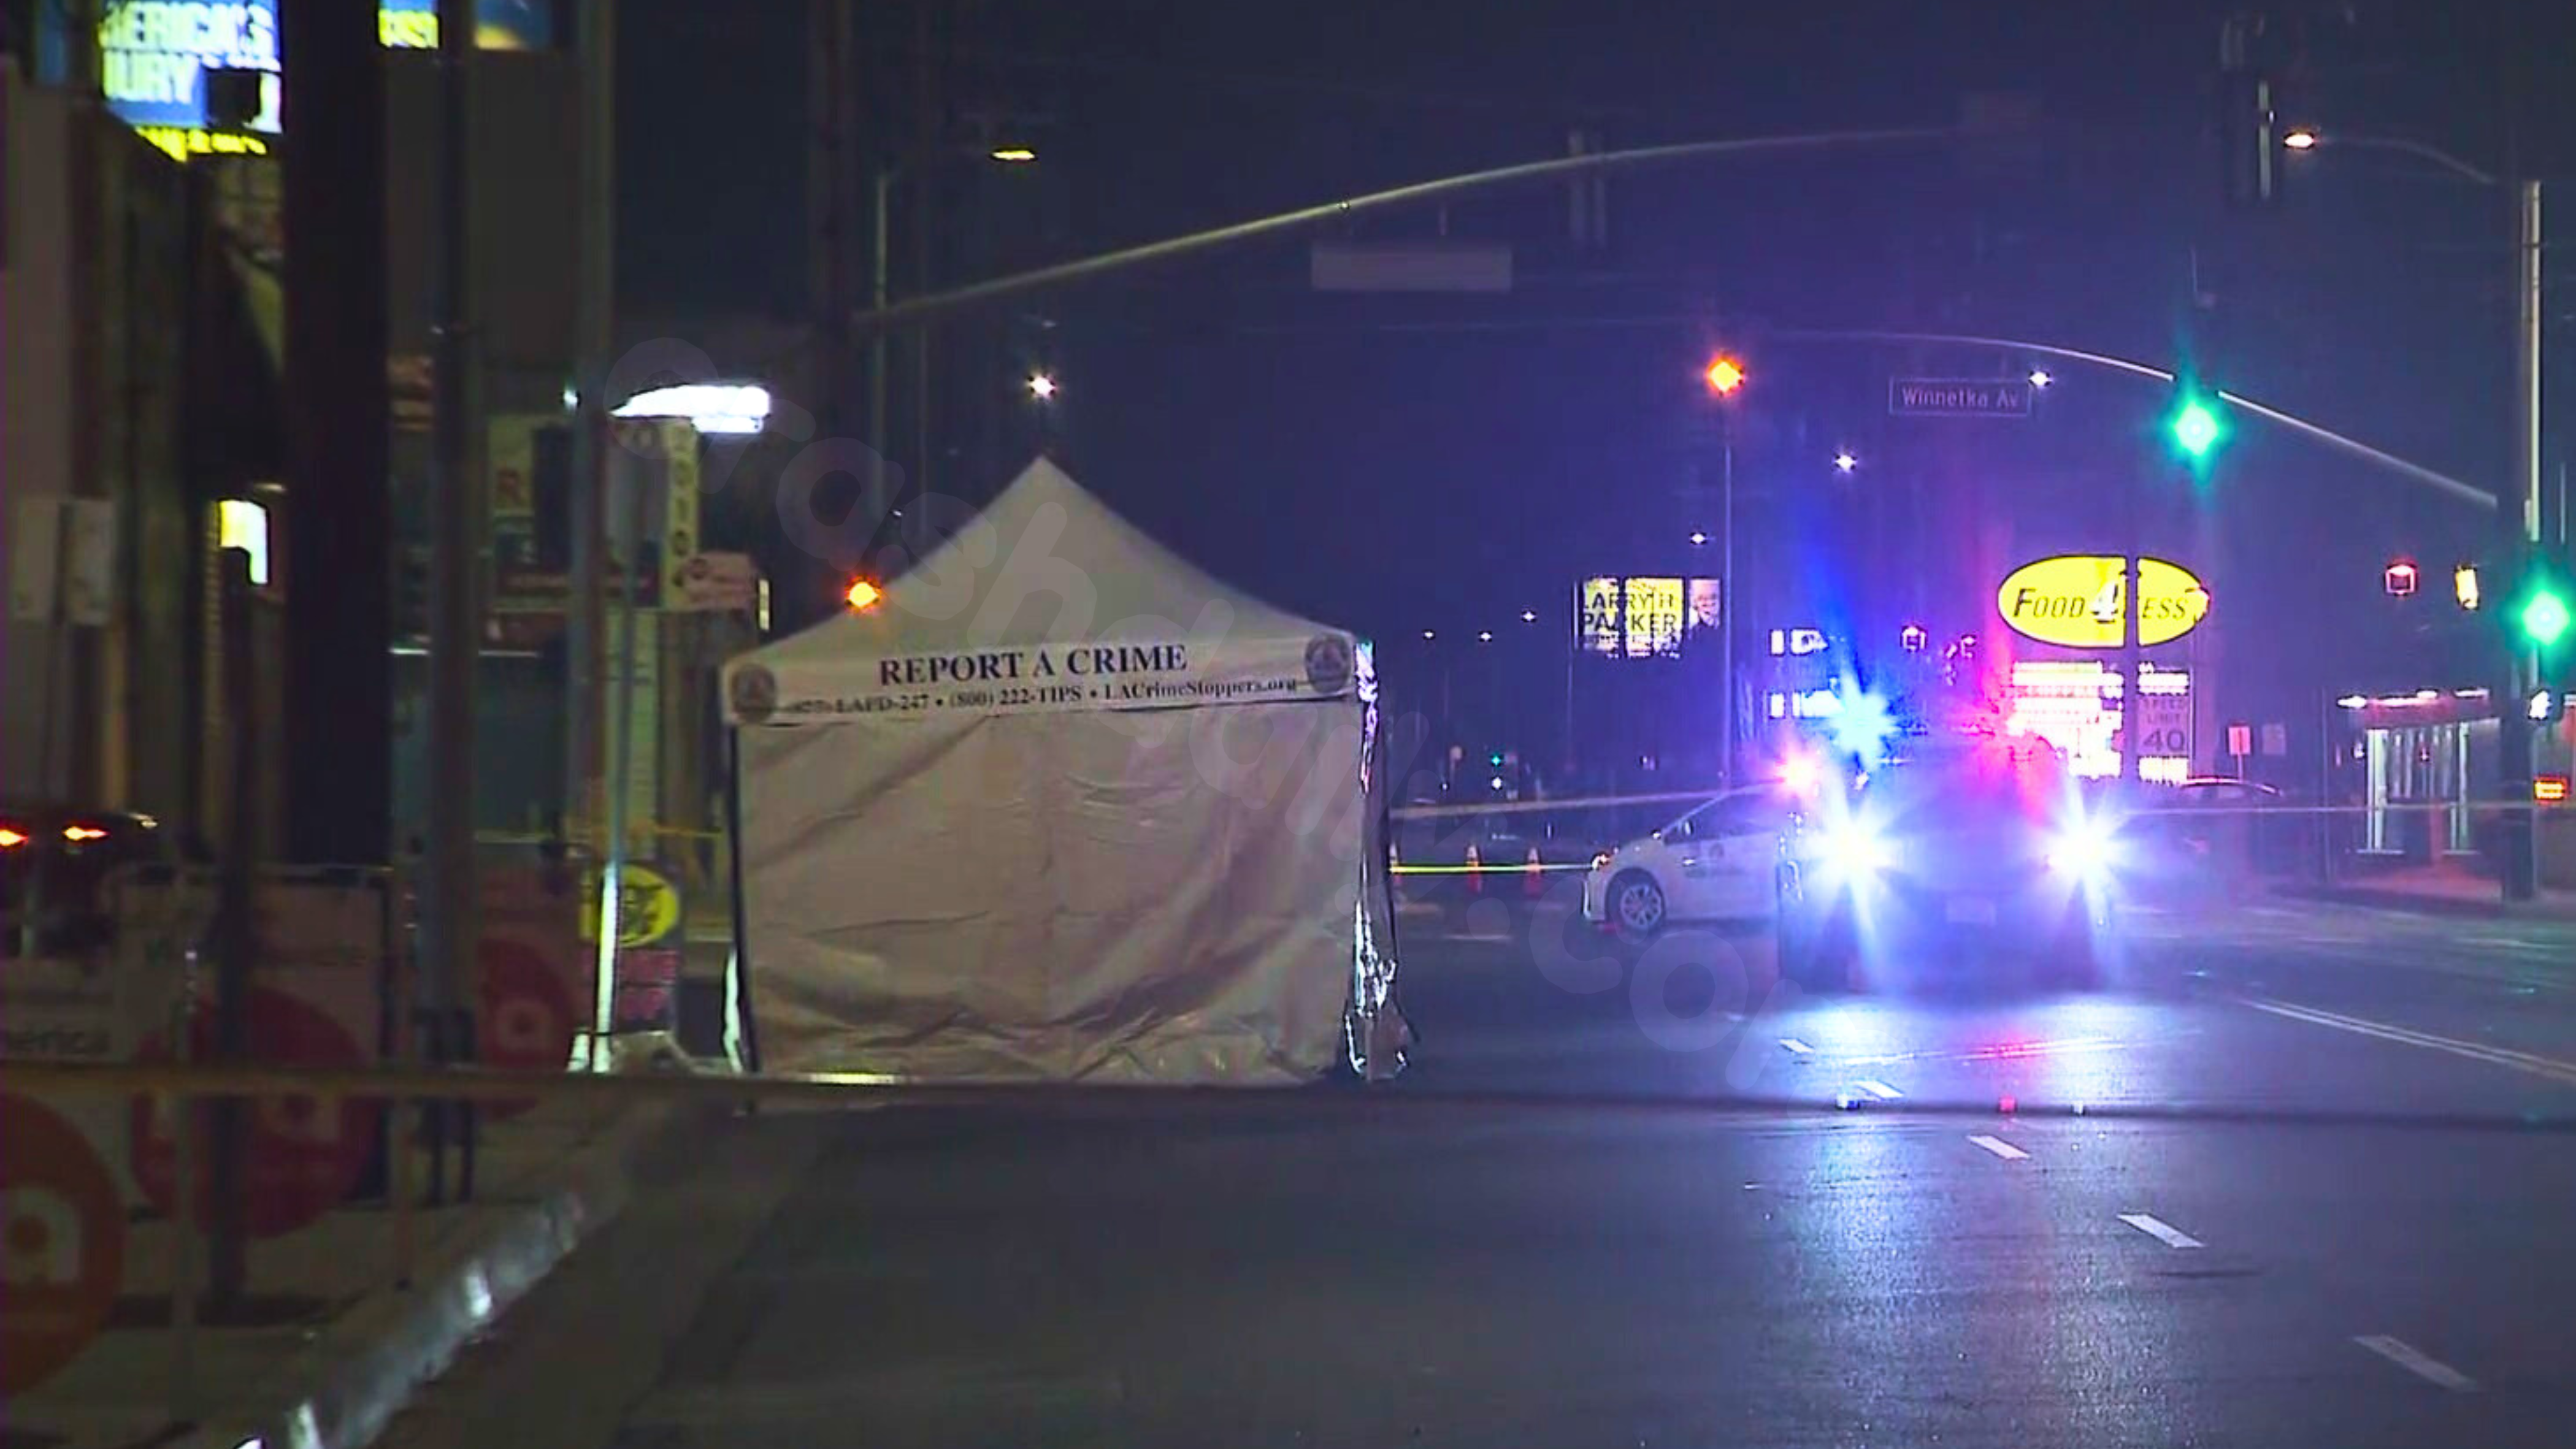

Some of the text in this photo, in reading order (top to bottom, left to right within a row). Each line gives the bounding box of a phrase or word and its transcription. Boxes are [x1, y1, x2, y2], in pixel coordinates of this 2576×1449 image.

[1903, 387, 2019, 407] Winnetka Av
[880, 644, 1187, 686] REPORT A CRIME
[999, 684, 1082, 705] 222-TIPS
[1105, 678, 1297, 700] LACrimeStoppers.org
[2142, 728, 2186, 752] 40
